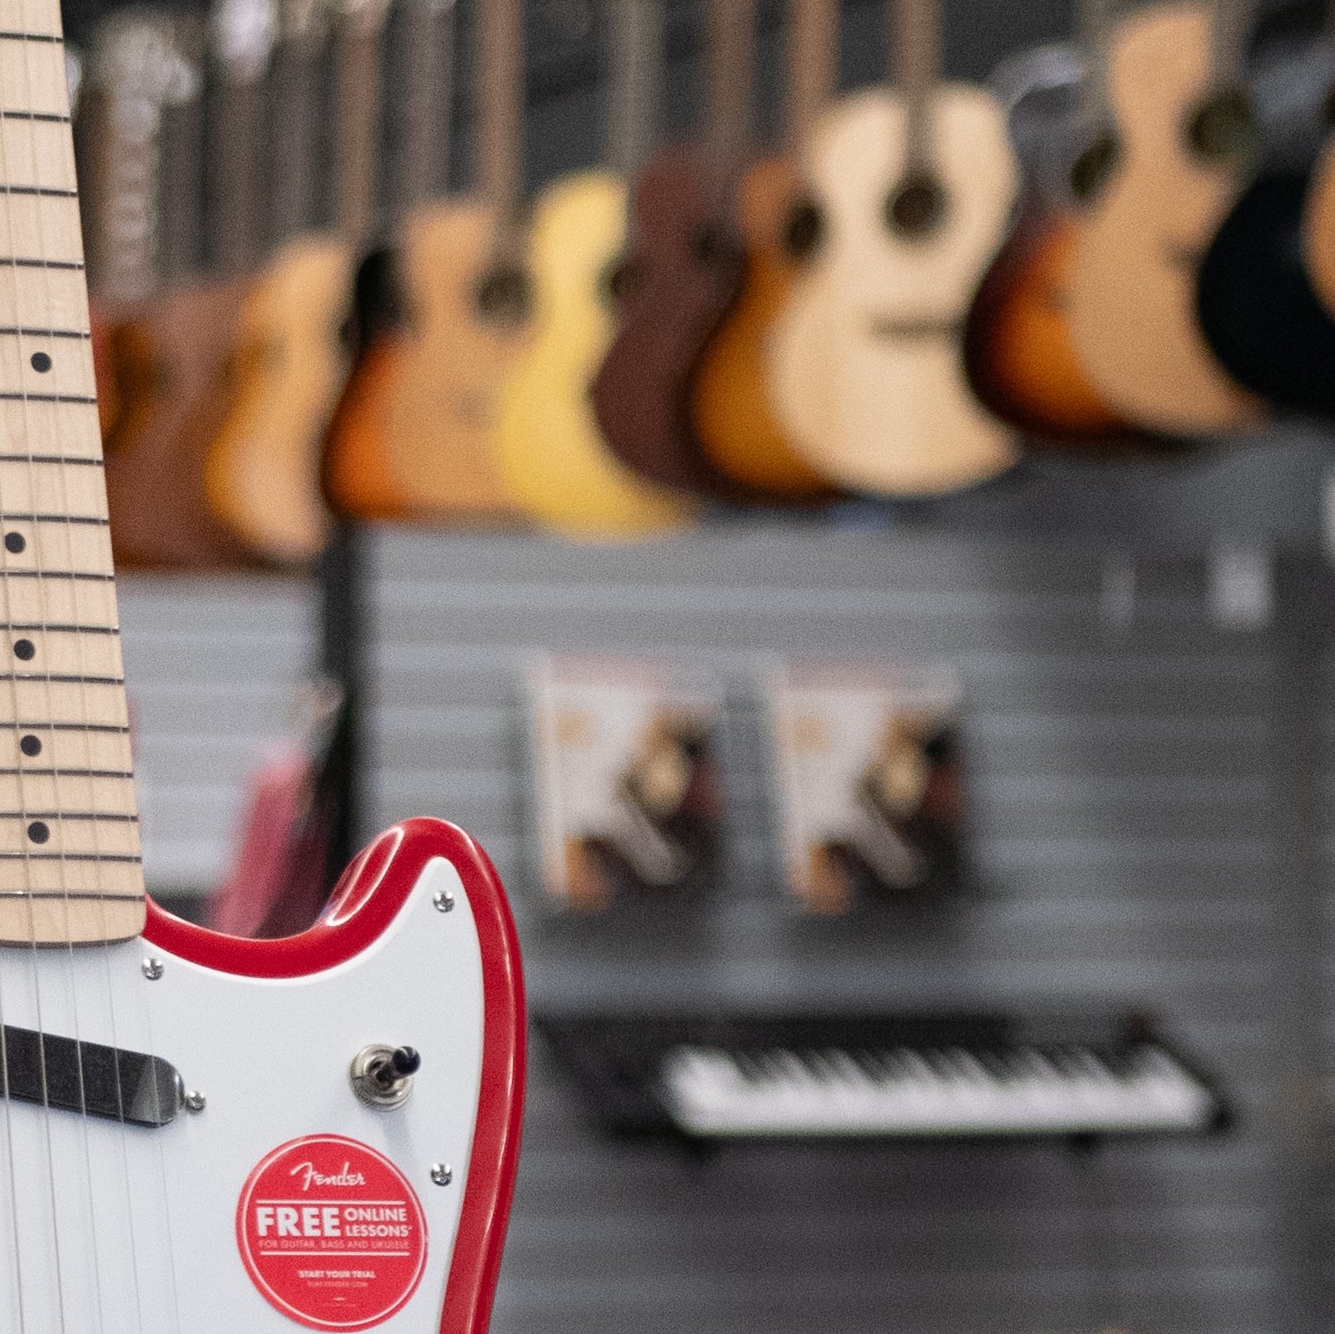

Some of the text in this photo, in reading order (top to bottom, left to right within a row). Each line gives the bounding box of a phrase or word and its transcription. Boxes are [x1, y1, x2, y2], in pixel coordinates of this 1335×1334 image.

[290, 1161, 366, 1191] Fender
[256, 1207, 341, 1237] FREE
[344, 1208, 407, 1222] ONLINE
[258, 1240, 278, 1249] FOR
[321, 1240, 345, 1249] BASS
[347, 1240, 369, 1249] AND
[298, 1270, 376, 1279] START YOUR TRIAL
